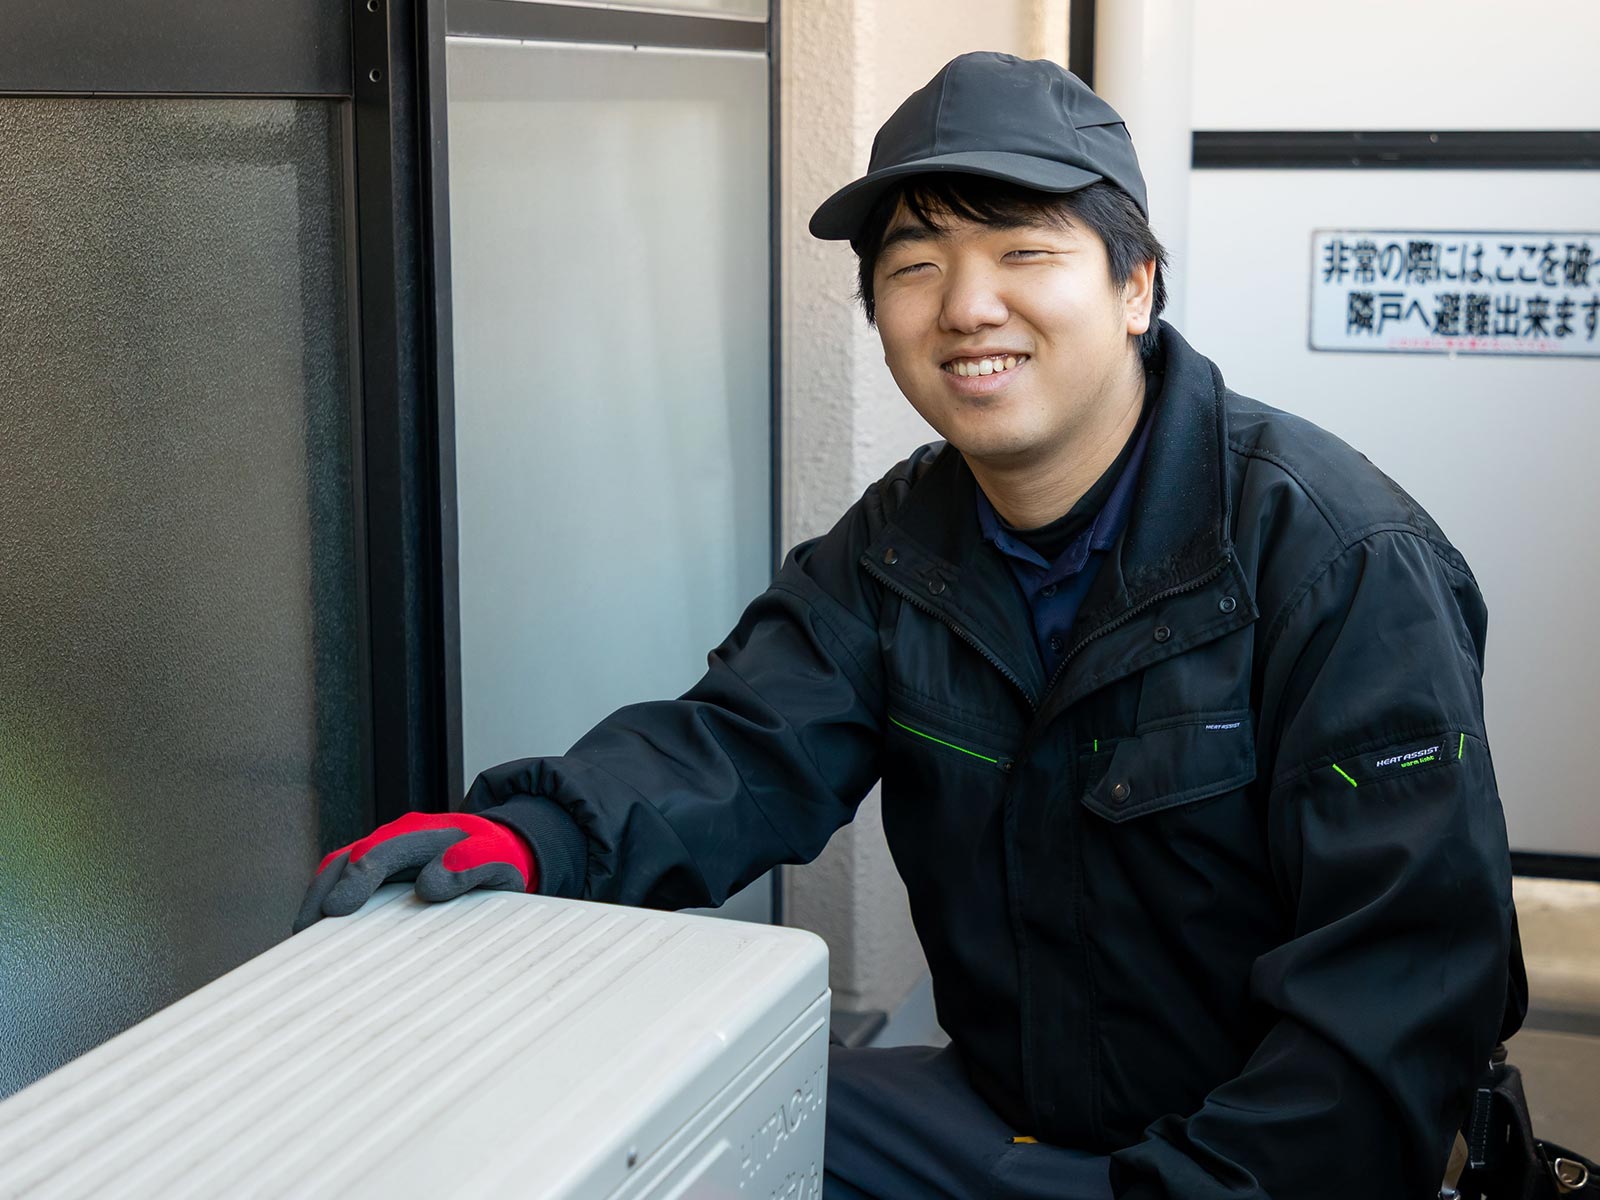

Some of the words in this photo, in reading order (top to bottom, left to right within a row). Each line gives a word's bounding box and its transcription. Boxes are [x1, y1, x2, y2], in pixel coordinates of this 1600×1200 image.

[1323, 239, 1600, 287] 非常の際には、ここを破
[1376, 755, 1403, 767] HEAT
[1403, 746, 1439, 760] ASSIST
[740, 1064, 823, 1188] HITACHI
